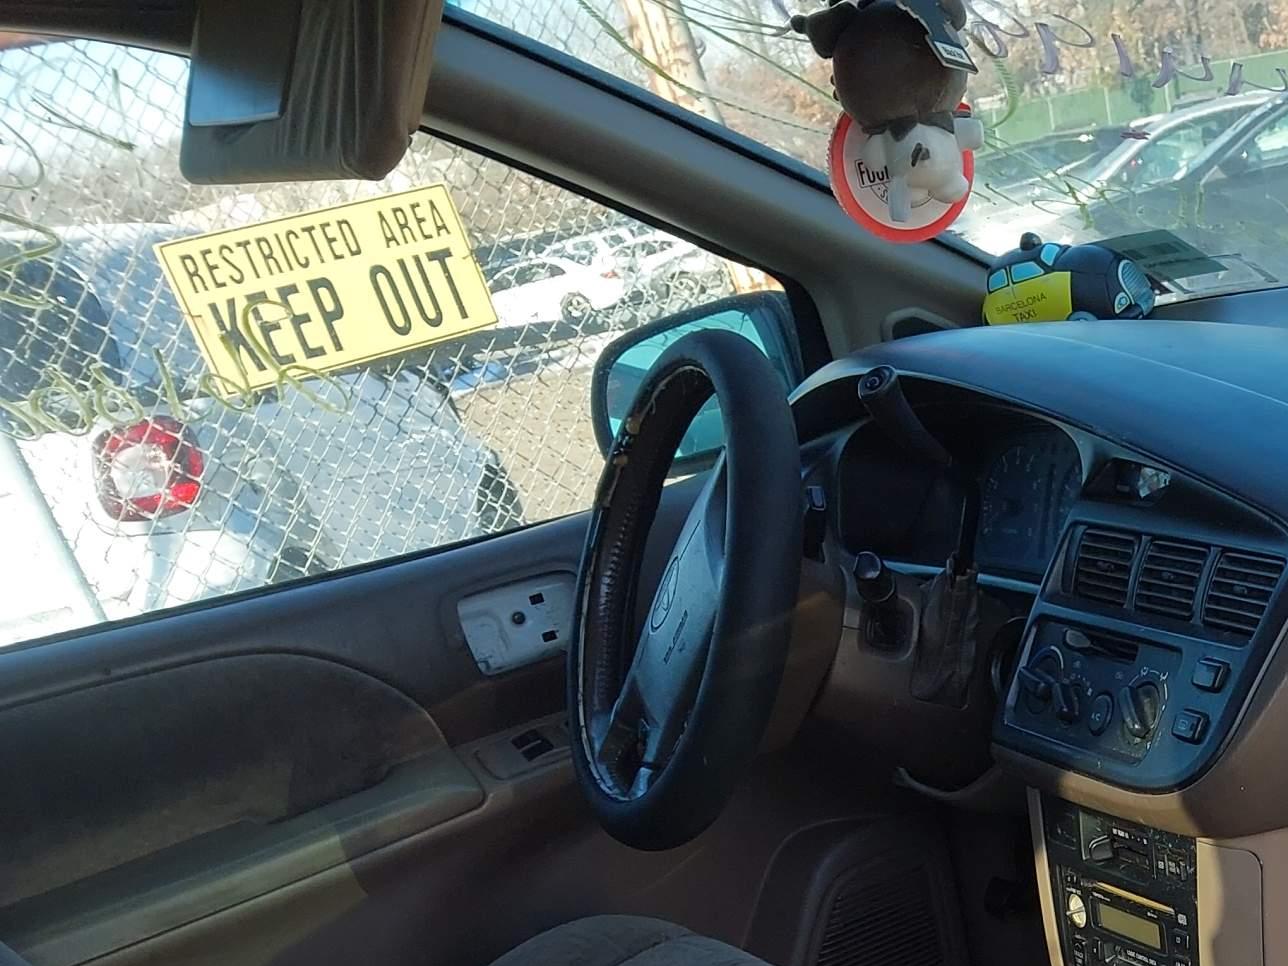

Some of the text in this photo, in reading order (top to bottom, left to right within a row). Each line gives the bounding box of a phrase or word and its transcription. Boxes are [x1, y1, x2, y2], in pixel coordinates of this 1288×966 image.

[179, 199, 451, 293] RESTRICTED AREA
[208, 247, 468, 371] KEEP OUT
[995, 291, 1047, 314] BARCELONA
